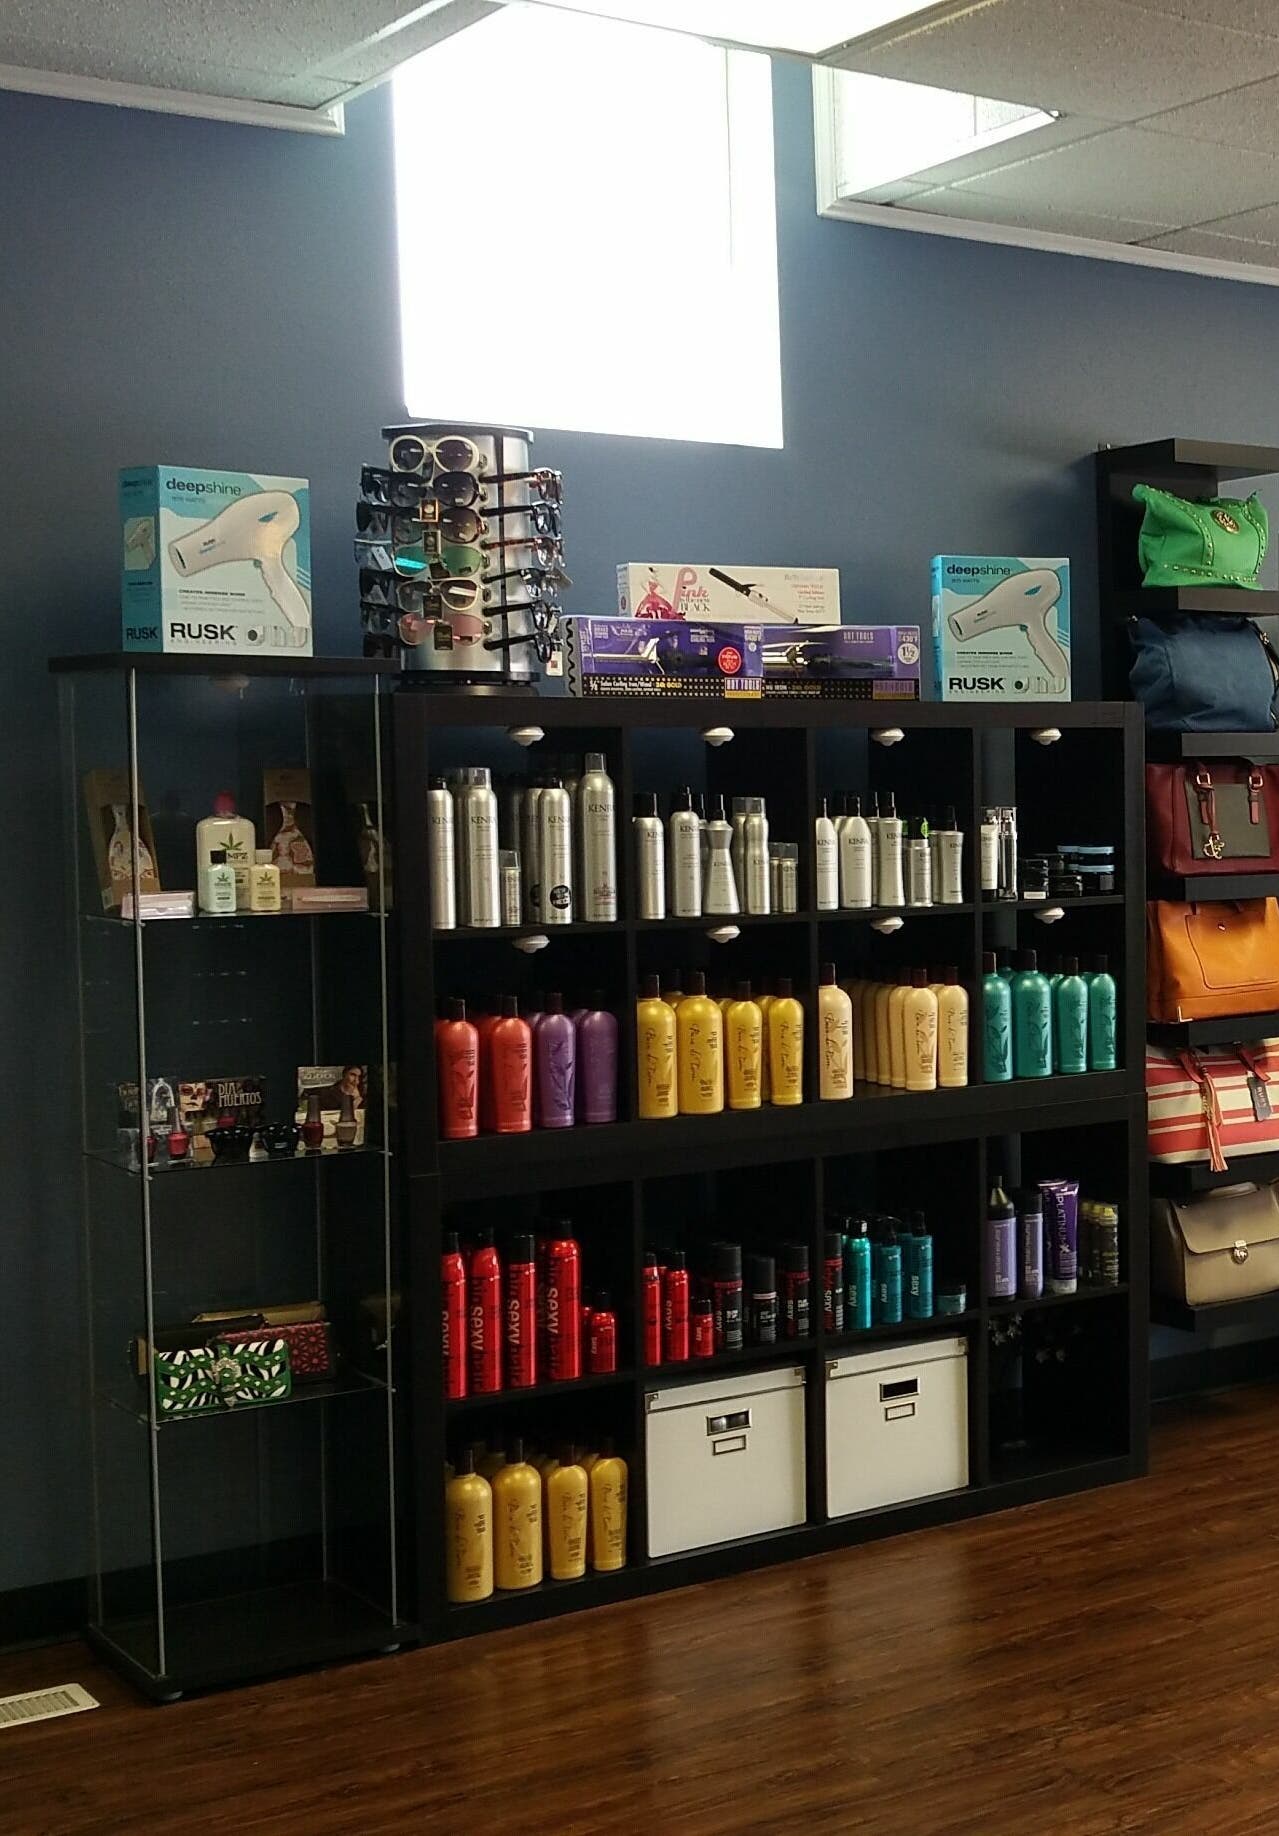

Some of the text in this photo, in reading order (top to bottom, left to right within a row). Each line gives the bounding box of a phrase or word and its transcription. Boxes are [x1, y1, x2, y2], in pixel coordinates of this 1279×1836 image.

[166, 478, 241, 496] deepshine
[947, 564, 1010, 576] deepshine
[126, 626, 158, 640] RUSK
[170, 622, 236, 640] RUSK
[949, 677, 1005, 690] RUSK
